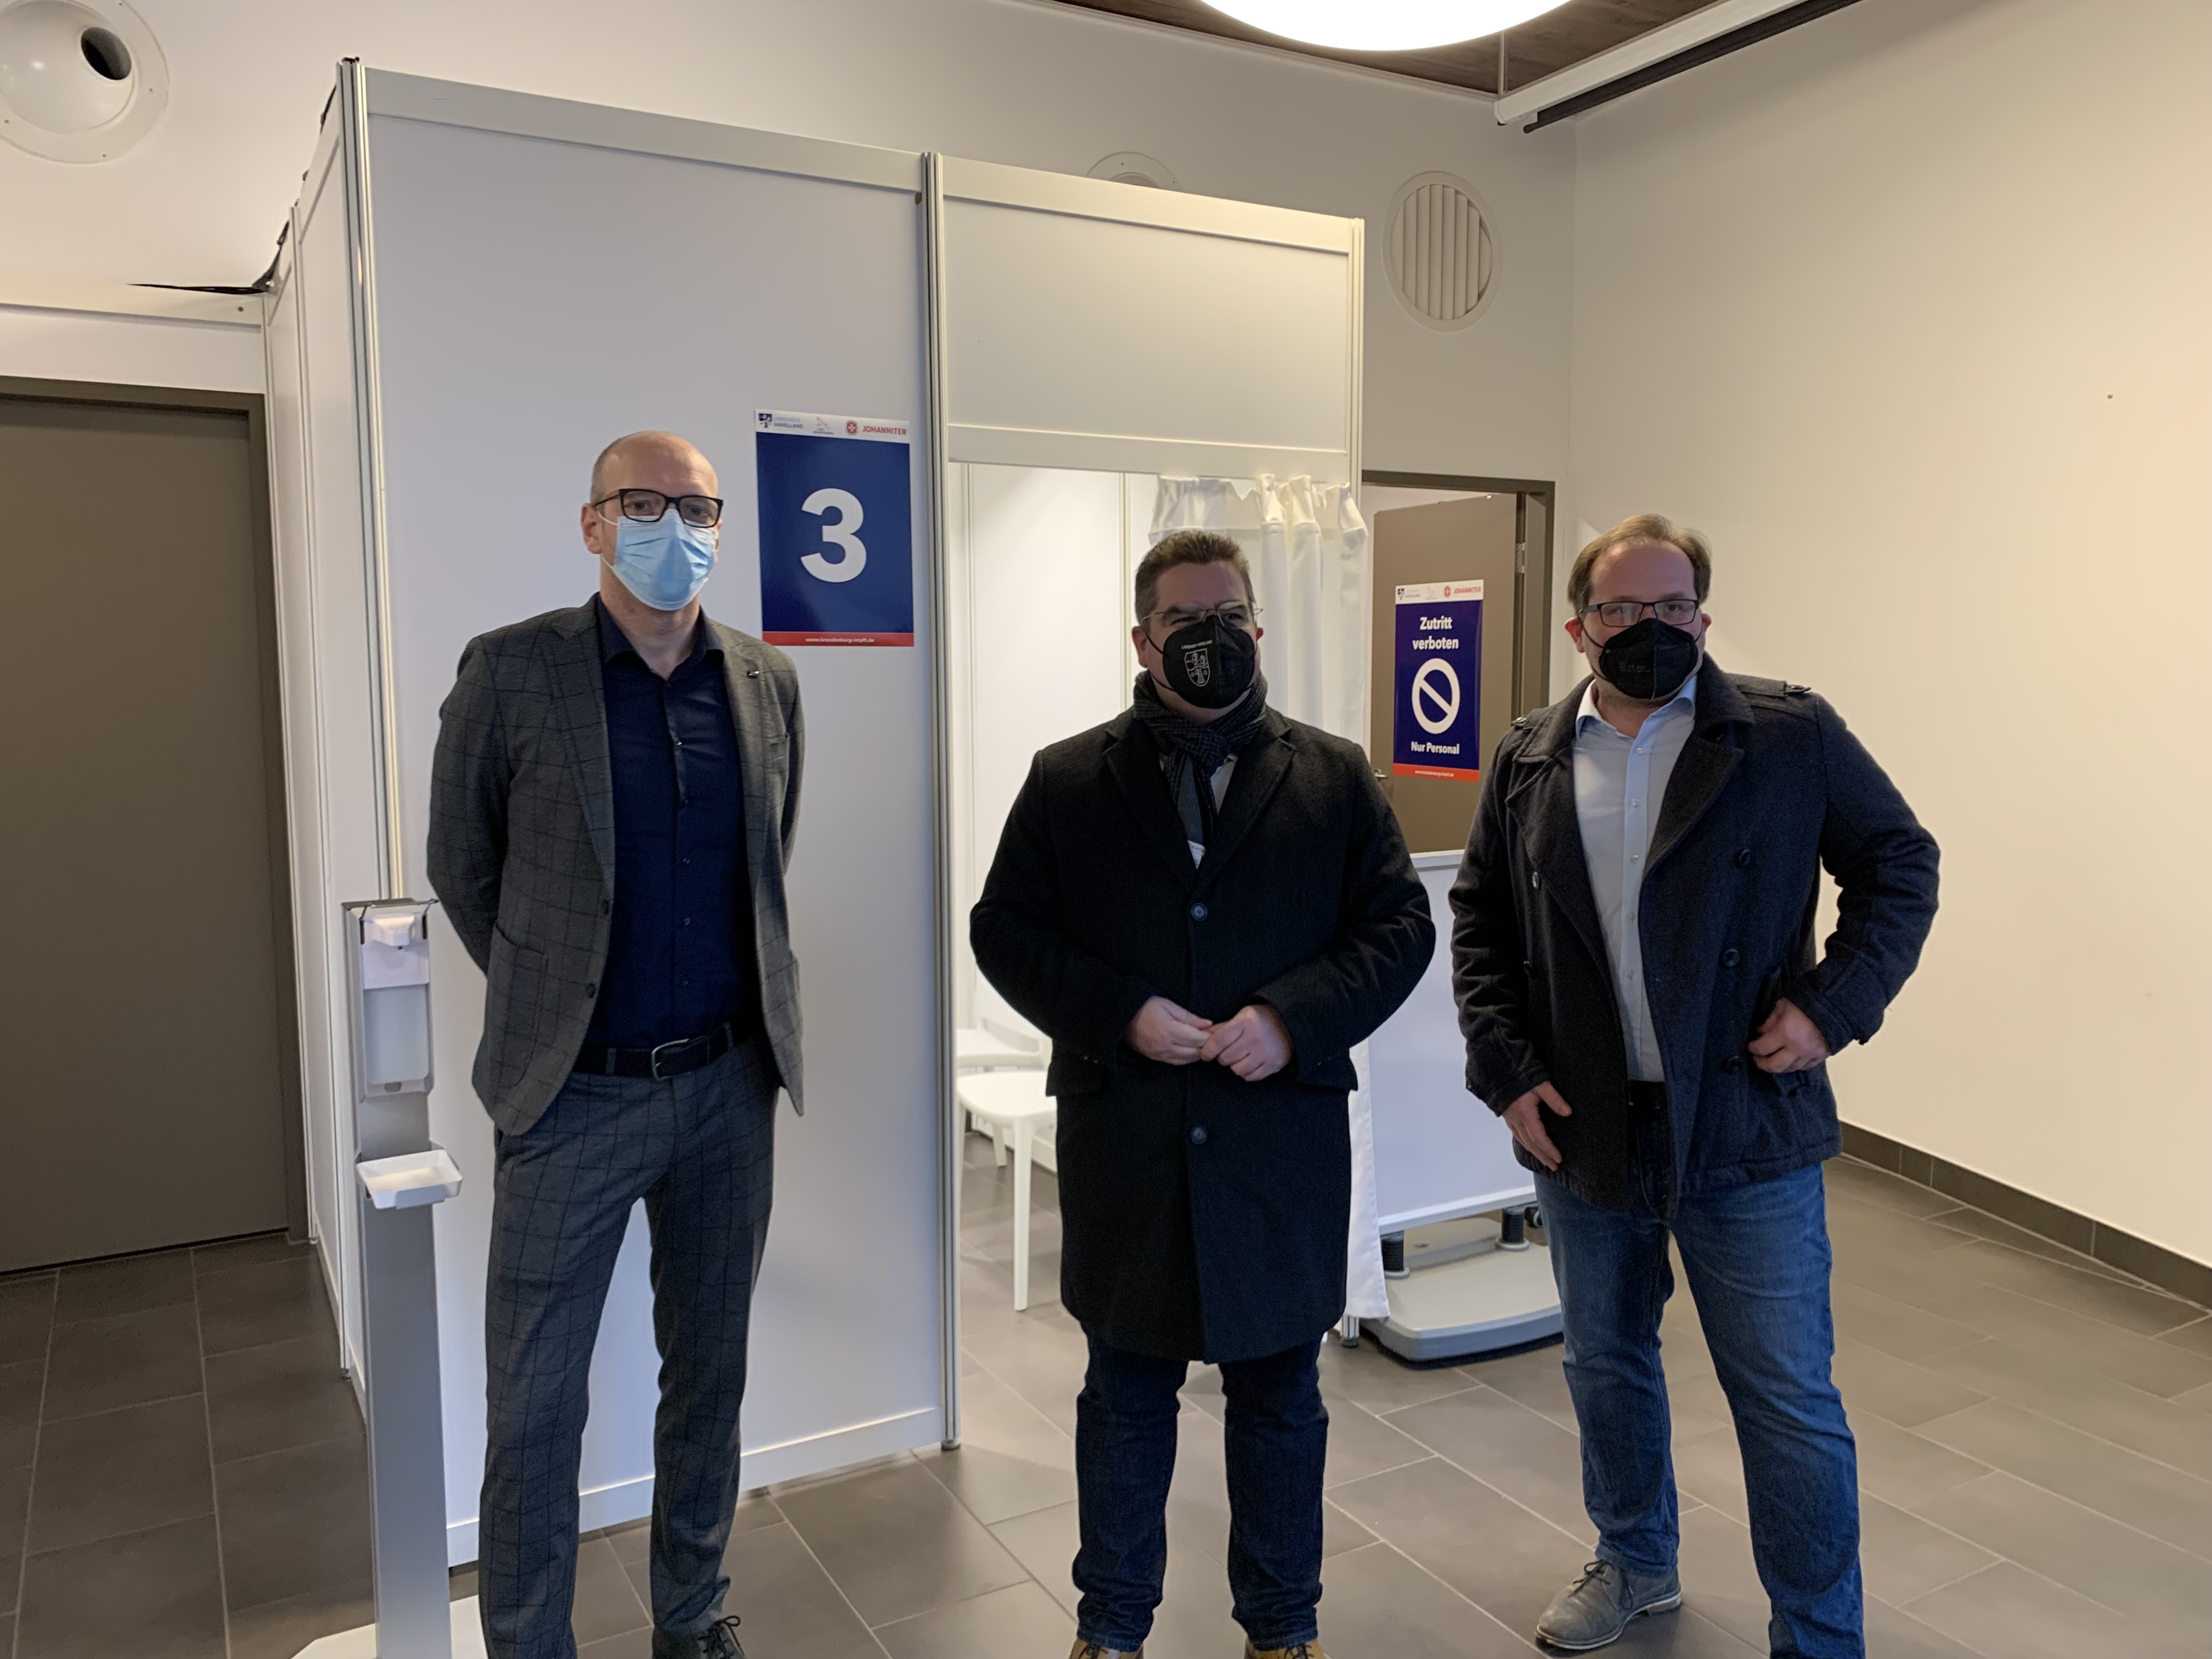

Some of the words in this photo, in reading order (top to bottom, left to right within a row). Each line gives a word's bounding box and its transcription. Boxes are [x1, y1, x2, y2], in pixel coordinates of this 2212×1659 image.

[862, 425, 907, 436] JOHANNITER
[800, 488, 867, 583] 3
[1453, 586, 1481, 595] JOHANNITER
[1419, 615, 1453, 630] Zutritt
[1412, 635, 1459, 651] verboten
[1410, 741, 1426, 753] Nur
[1426, 742, 1460, 755] Personal
